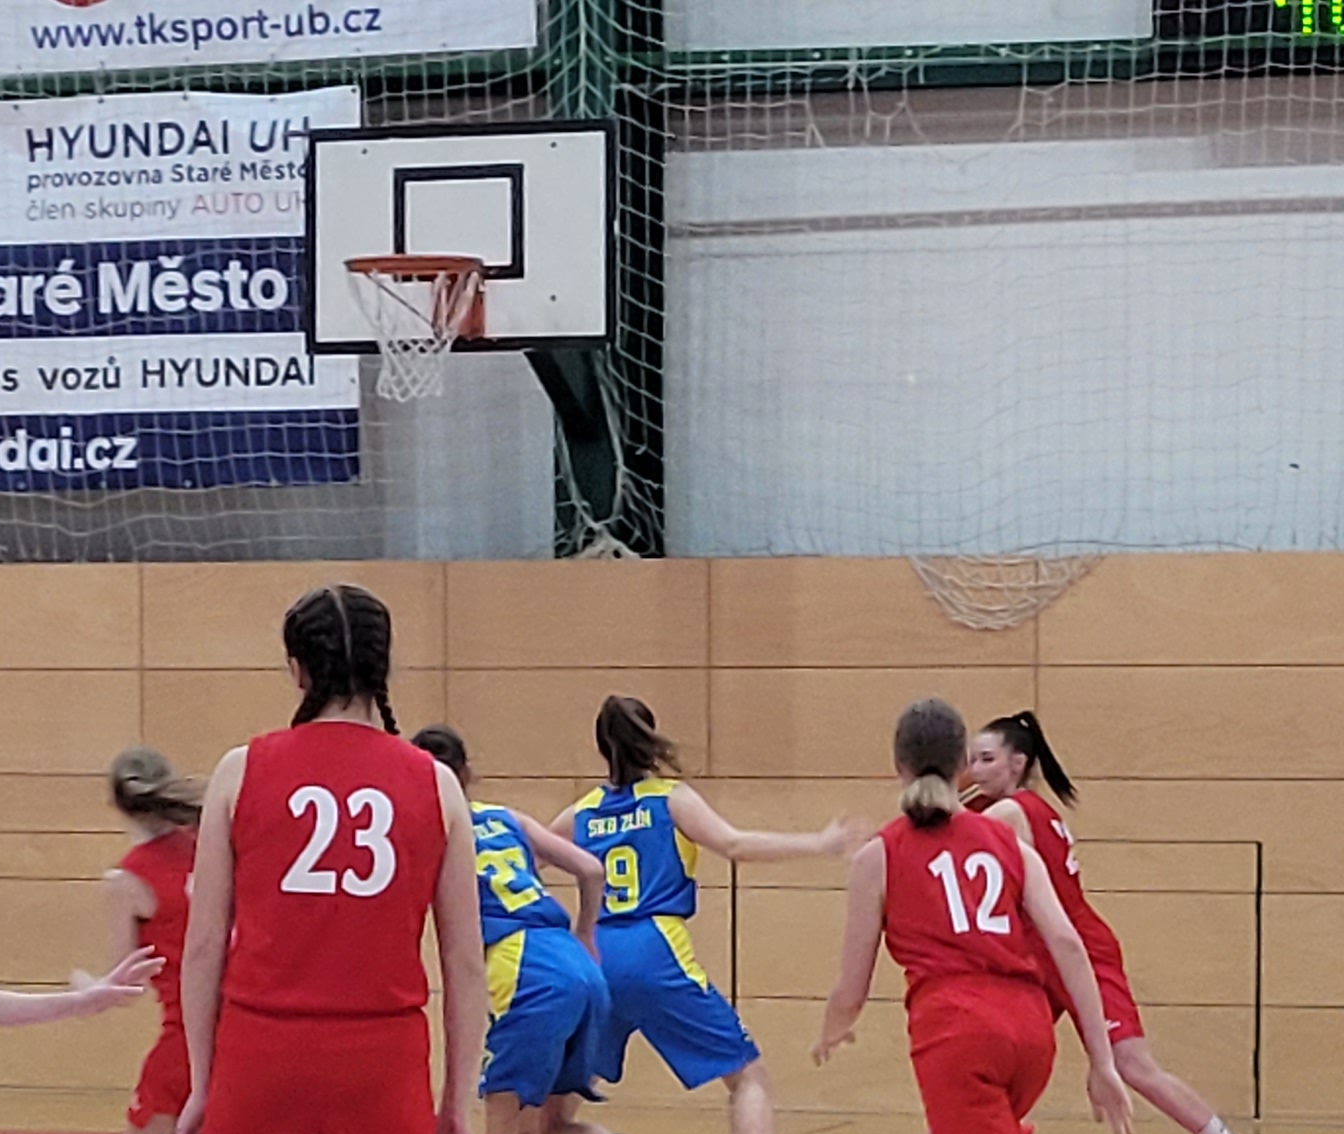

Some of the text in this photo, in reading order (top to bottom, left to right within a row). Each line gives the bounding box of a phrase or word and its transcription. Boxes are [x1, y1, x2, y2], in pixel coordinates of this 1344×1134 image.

[31, 4, 382, 50] www.tksport-ub.cz
[26, 117, 309, 162] HYUNDAI UH
[27, 167, 163, 193] provozovna
[171, 162, 232, 184] Staré
[26, 199, 75, 222] člen
[84, 195, 181, 221] skupiny
[191, 192, 264, 217] AUTO
[98, 254, 289, 315] Město
[39, 354, 122, 392] vozů
[139, 354, 315, 389] HYUNDAI
[280, 785, 397, 897] 23
[606, 845, 639, 913] 9
[927, 849, 1011, 934] 12
